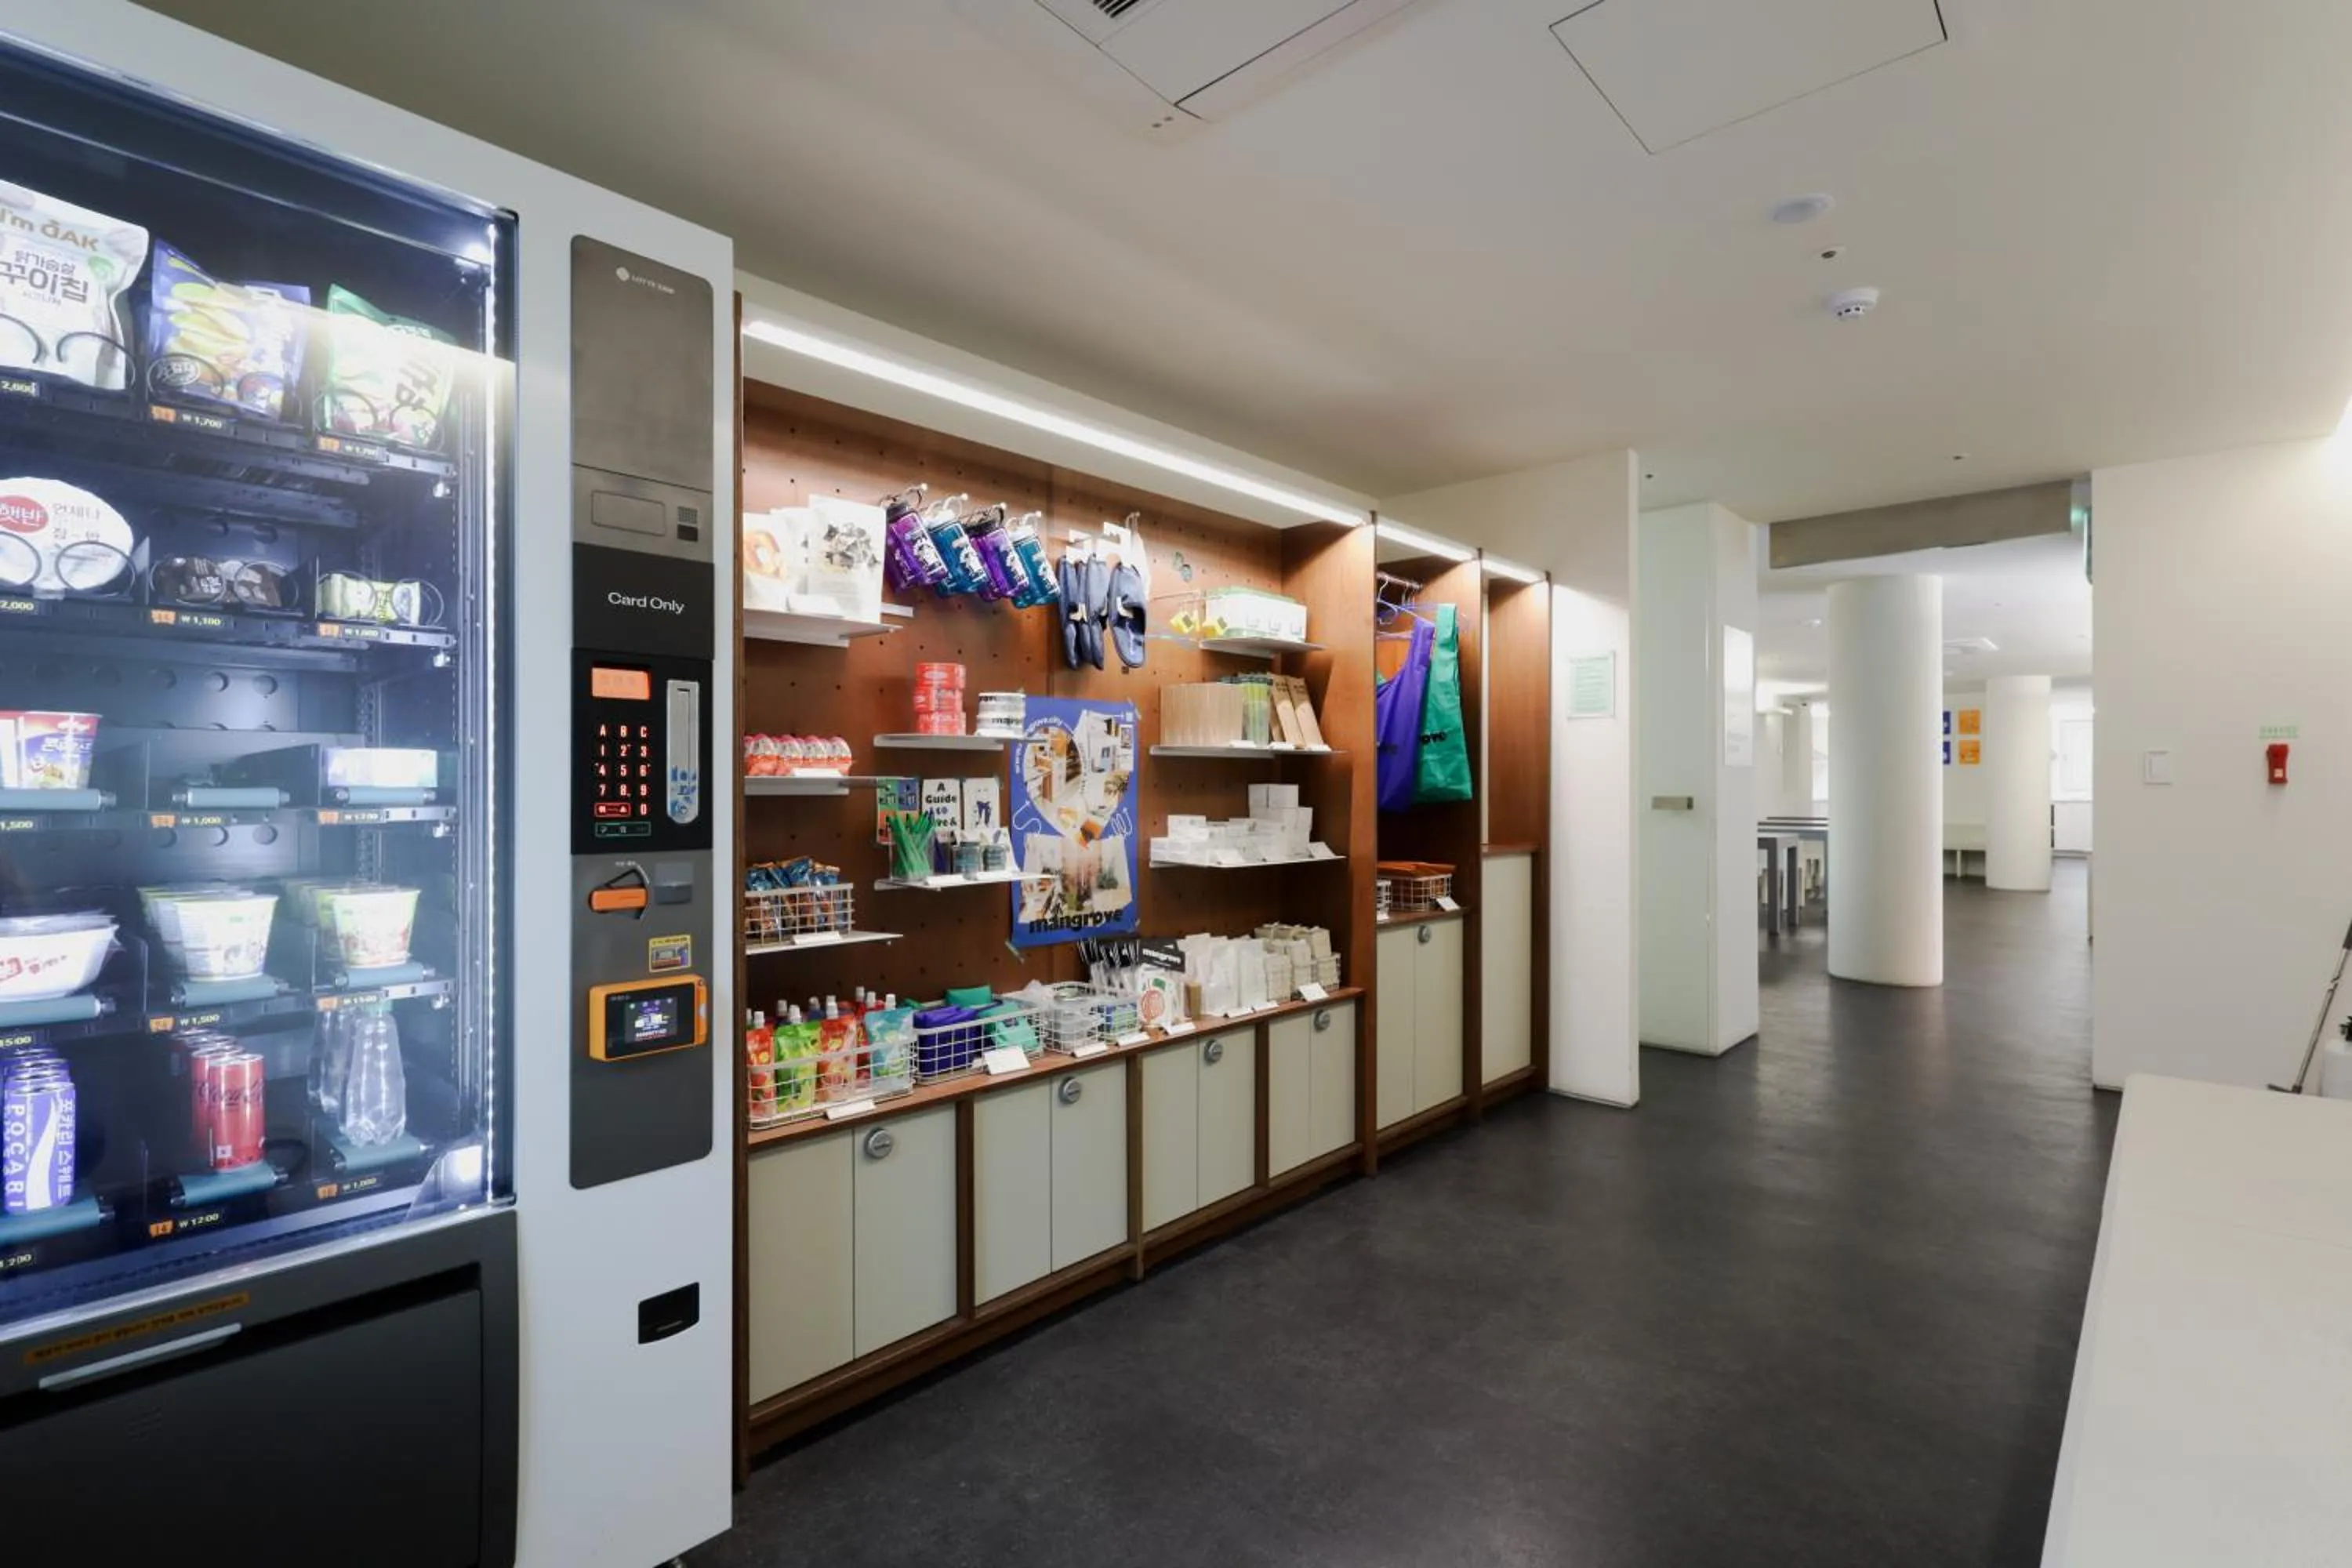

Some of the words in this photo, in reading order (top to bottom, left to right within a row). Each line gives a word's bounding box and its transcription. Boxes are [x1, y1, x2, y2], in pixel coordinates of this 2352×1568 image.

[608, 591, 648, 608] Card
[650, 597, 684, 615] Only
[599, 724, 607, 737] A
[640, 725, 647, 738] C
[620, 746, 627, 757] 2
[640, 746, 647, 757] 3
[598, 764, 606, 775] 4
[620, 764, 626, 776] 5
[639, 764, 646, 777] 6
[599, 784, 606, 797] 7
[620, 785, 627, 796] 8
[640, 785, 647, 797] 9
[937, 782, 946, 792] A
[925, 794, 957, 804] Guide
[640, 804, 647, 815] 0
[1029, 909, 1123, 934] mangrove
